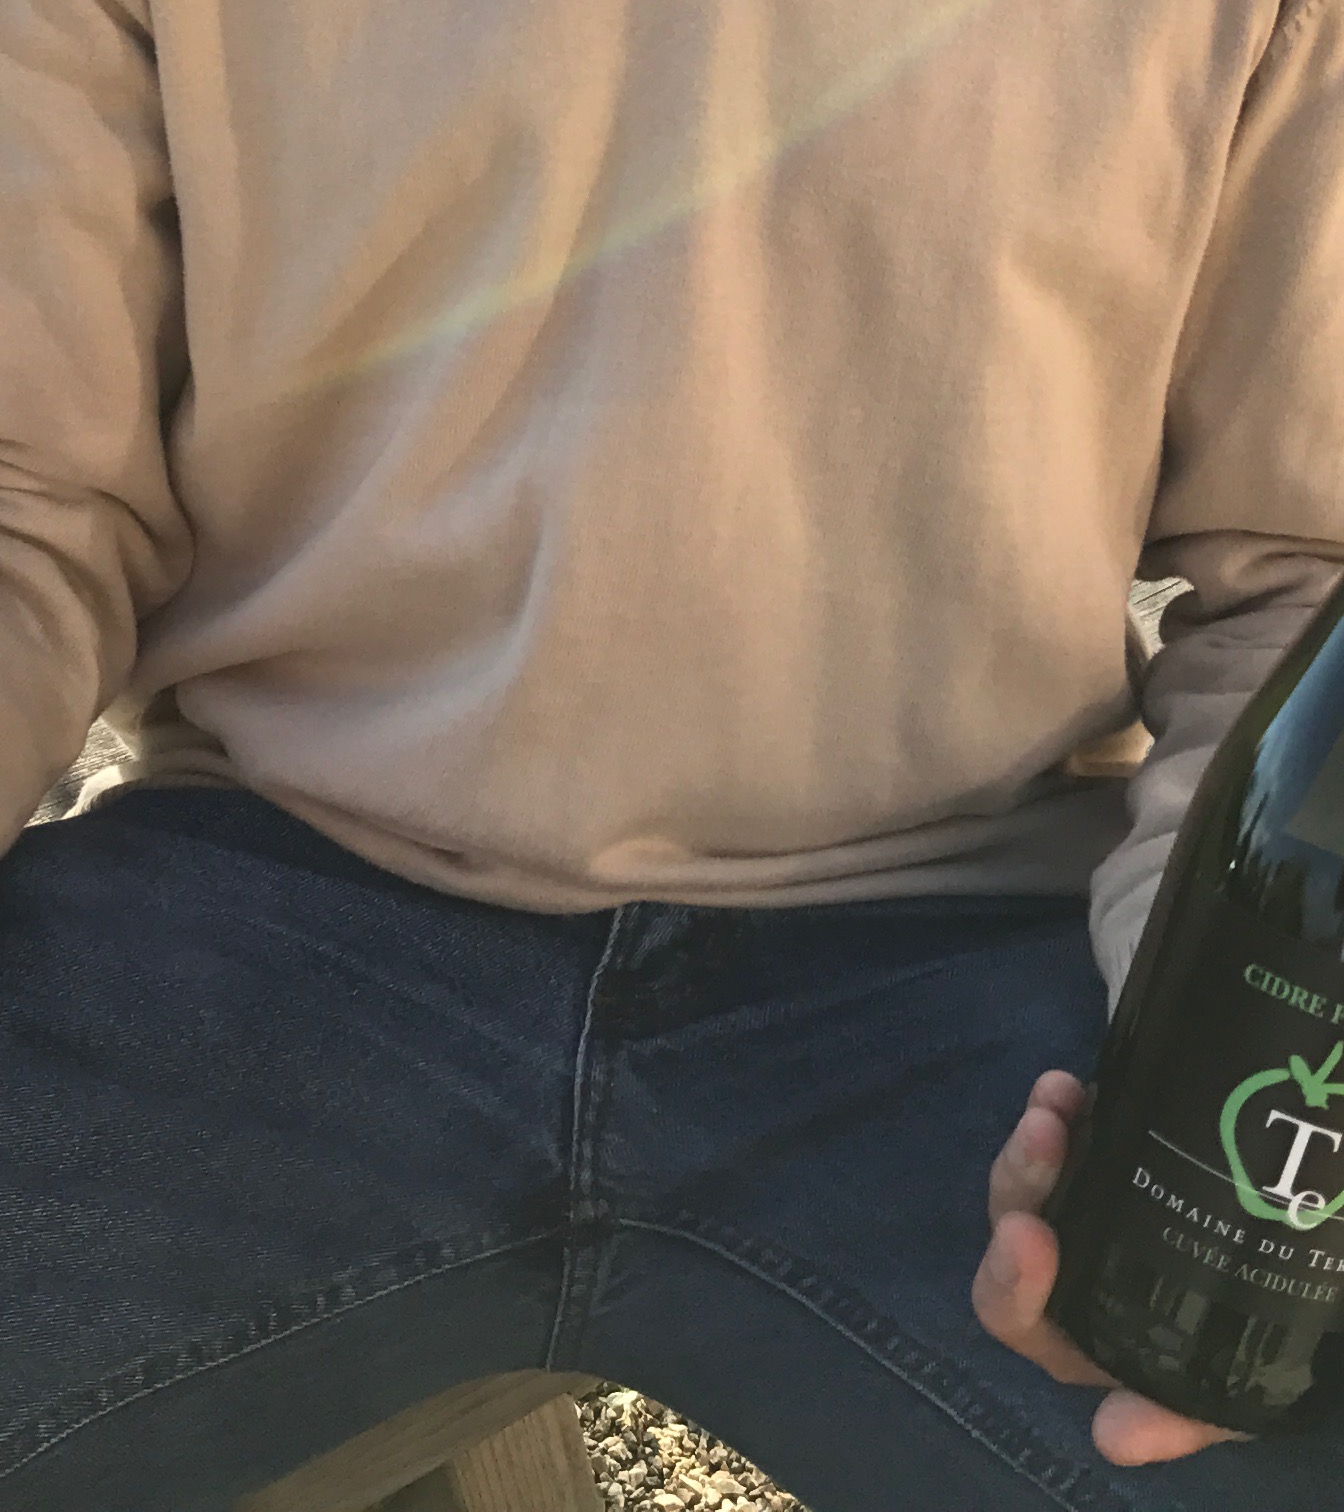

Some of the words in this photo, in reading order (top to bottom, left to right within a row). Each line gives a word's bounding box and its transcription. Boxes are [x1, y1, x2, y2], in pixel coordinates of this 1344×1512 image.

[1243, 963, 1327, 1019] CIDRE
[1163, 1226, 1230, 1272] CUVÉE
[1234, 1263, 1339, 1304] ACIDULÉE
